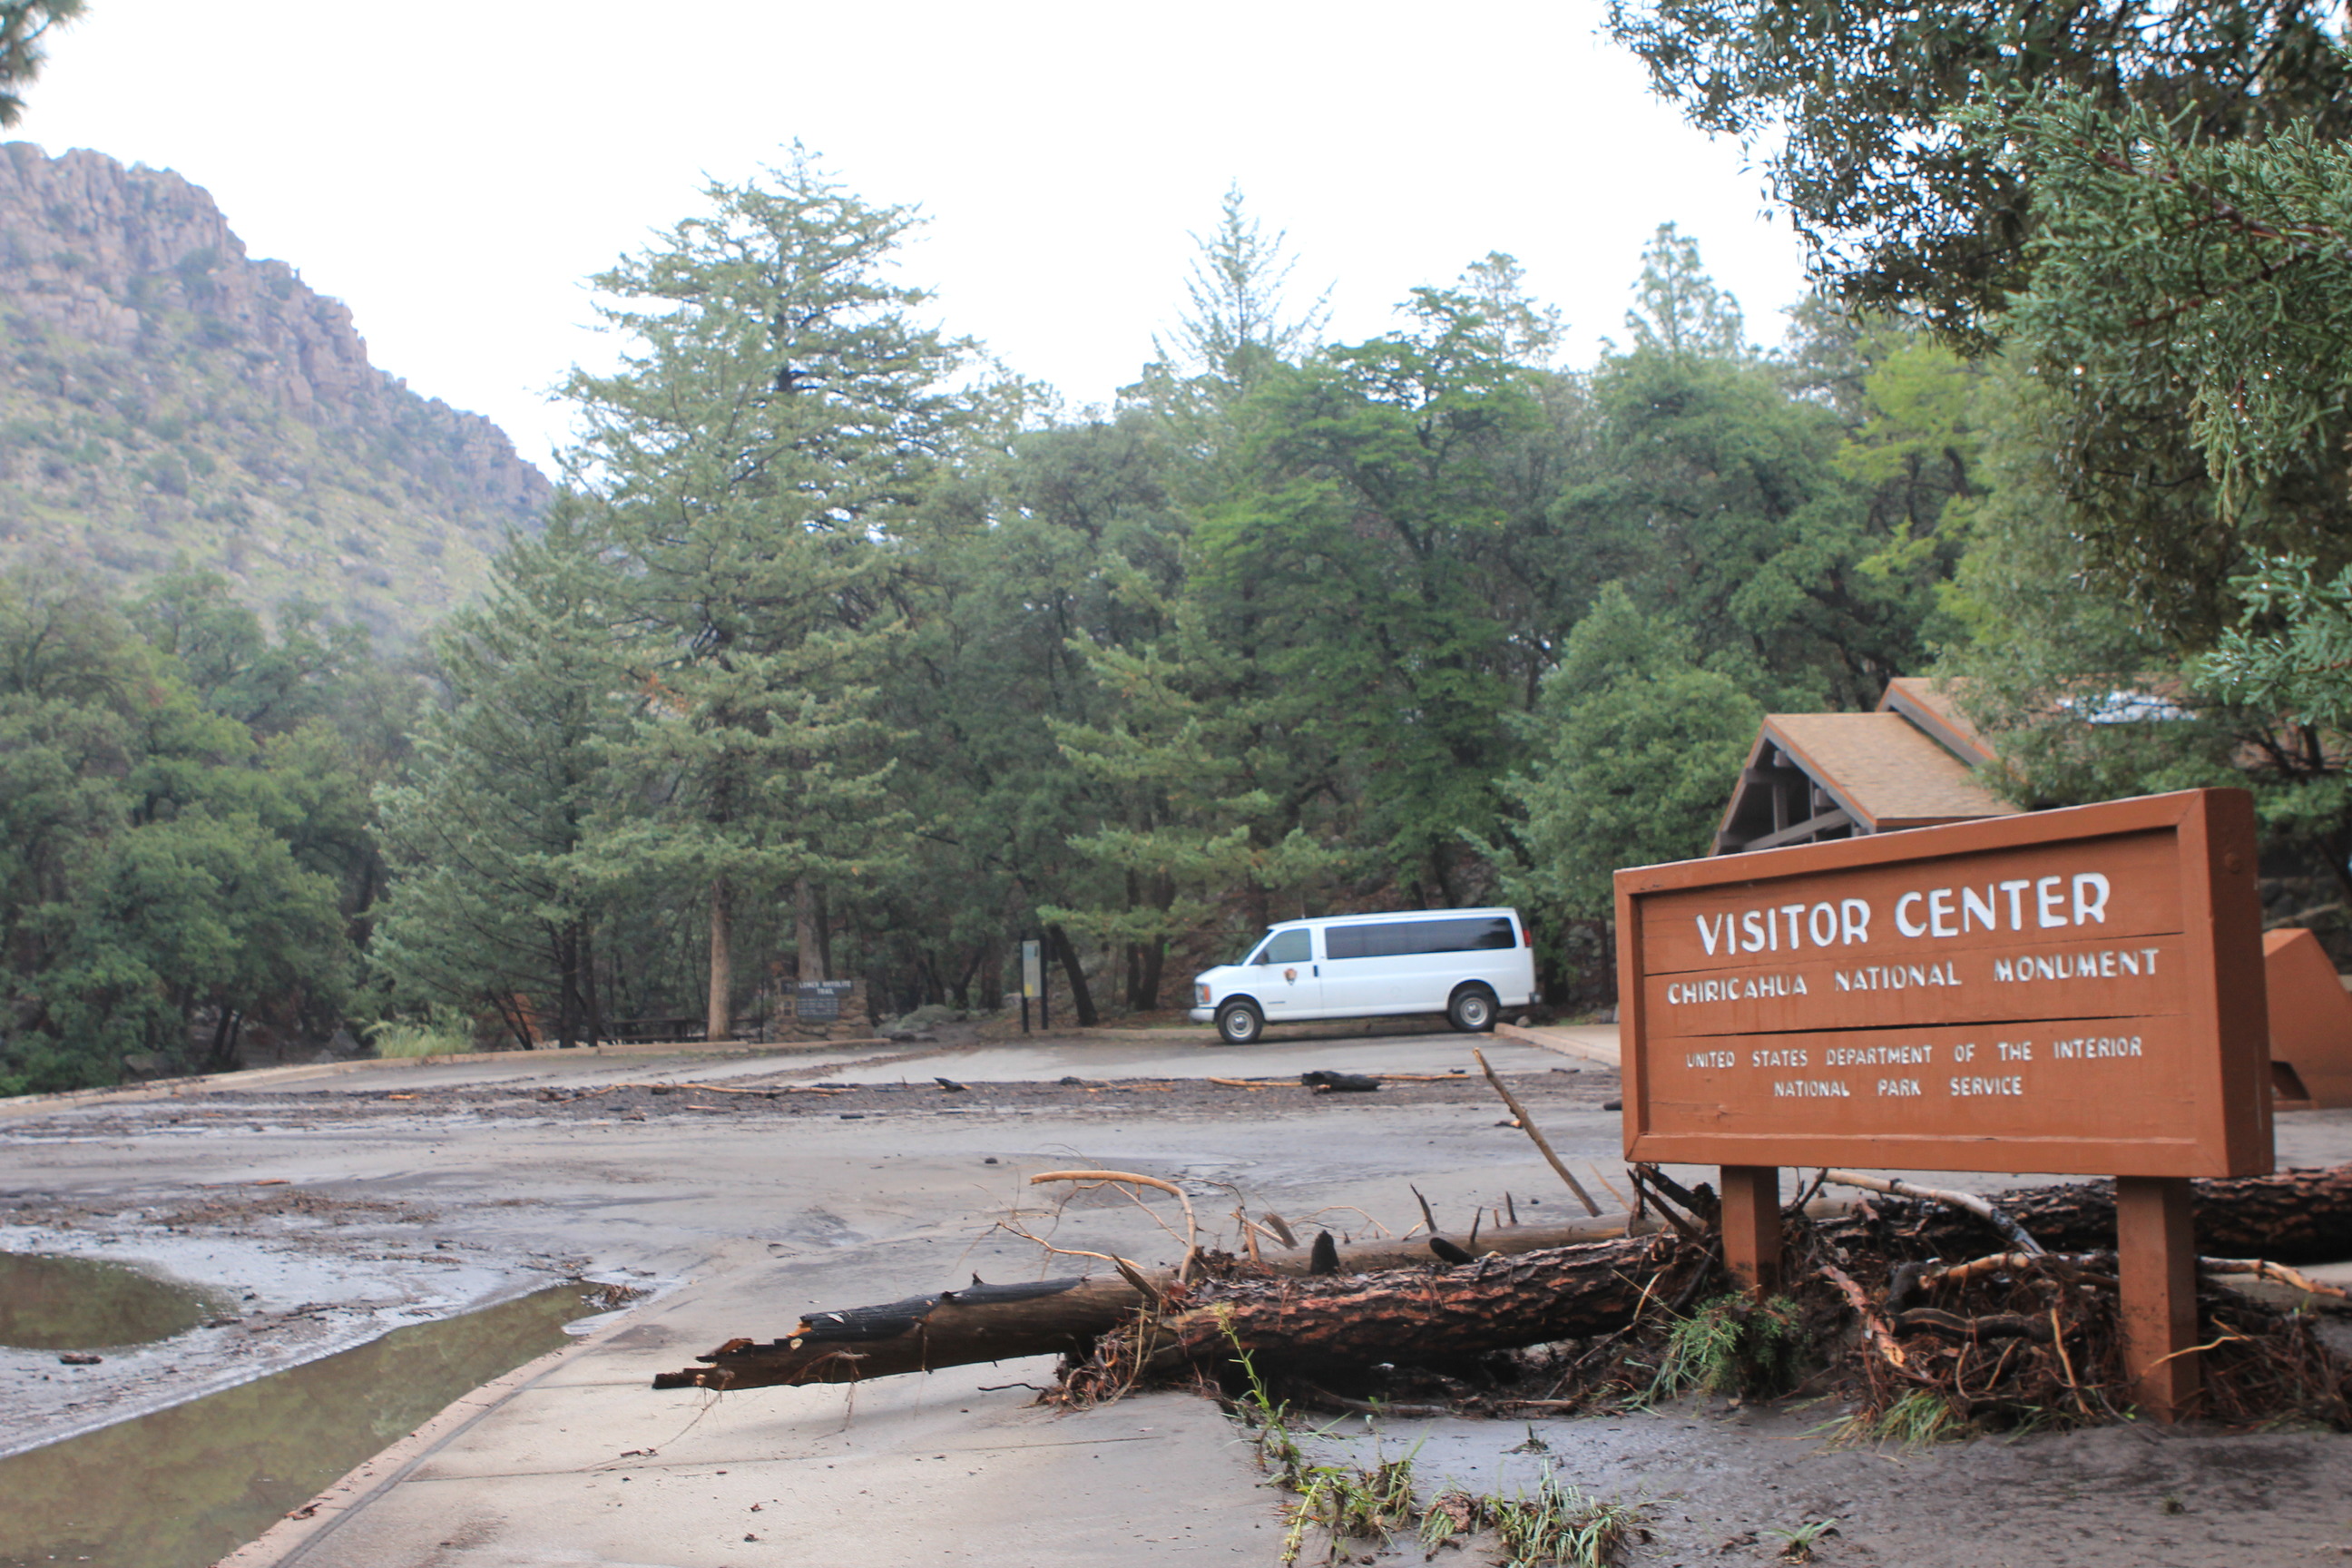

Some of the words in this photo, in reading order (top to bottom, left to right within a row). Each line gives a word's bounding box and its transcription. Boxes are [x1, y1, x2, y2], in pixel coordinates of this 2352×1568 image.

[1696, 898, 1871, 956] VISITOR
[1895, 872, 2111, 938] CENTER
[1667, 975, 1808, 1004] CHIRICAHUA
[1835, 962, 1962, 992] NATIONAL
[1994, 948, 2159, 982] MONUMENT
[1686, 1051, 1735, 1069] UNITED
[1752, 1049, 1808, 1067] STATES
[1826, 1044, 1933, 1066] DEPARTMENT
[1954, 1043, 1975, 1063] OF
[1997, 1041, 2033, 1062] THE
[2053, 1036, 2142, 1059] INTERIOR
[1774, 1080, 1850, 1097] NATIONAL
[1877, 1078, 1922, 1096] PARK
[1950, 1076, 2023, 1096] SERVICE
